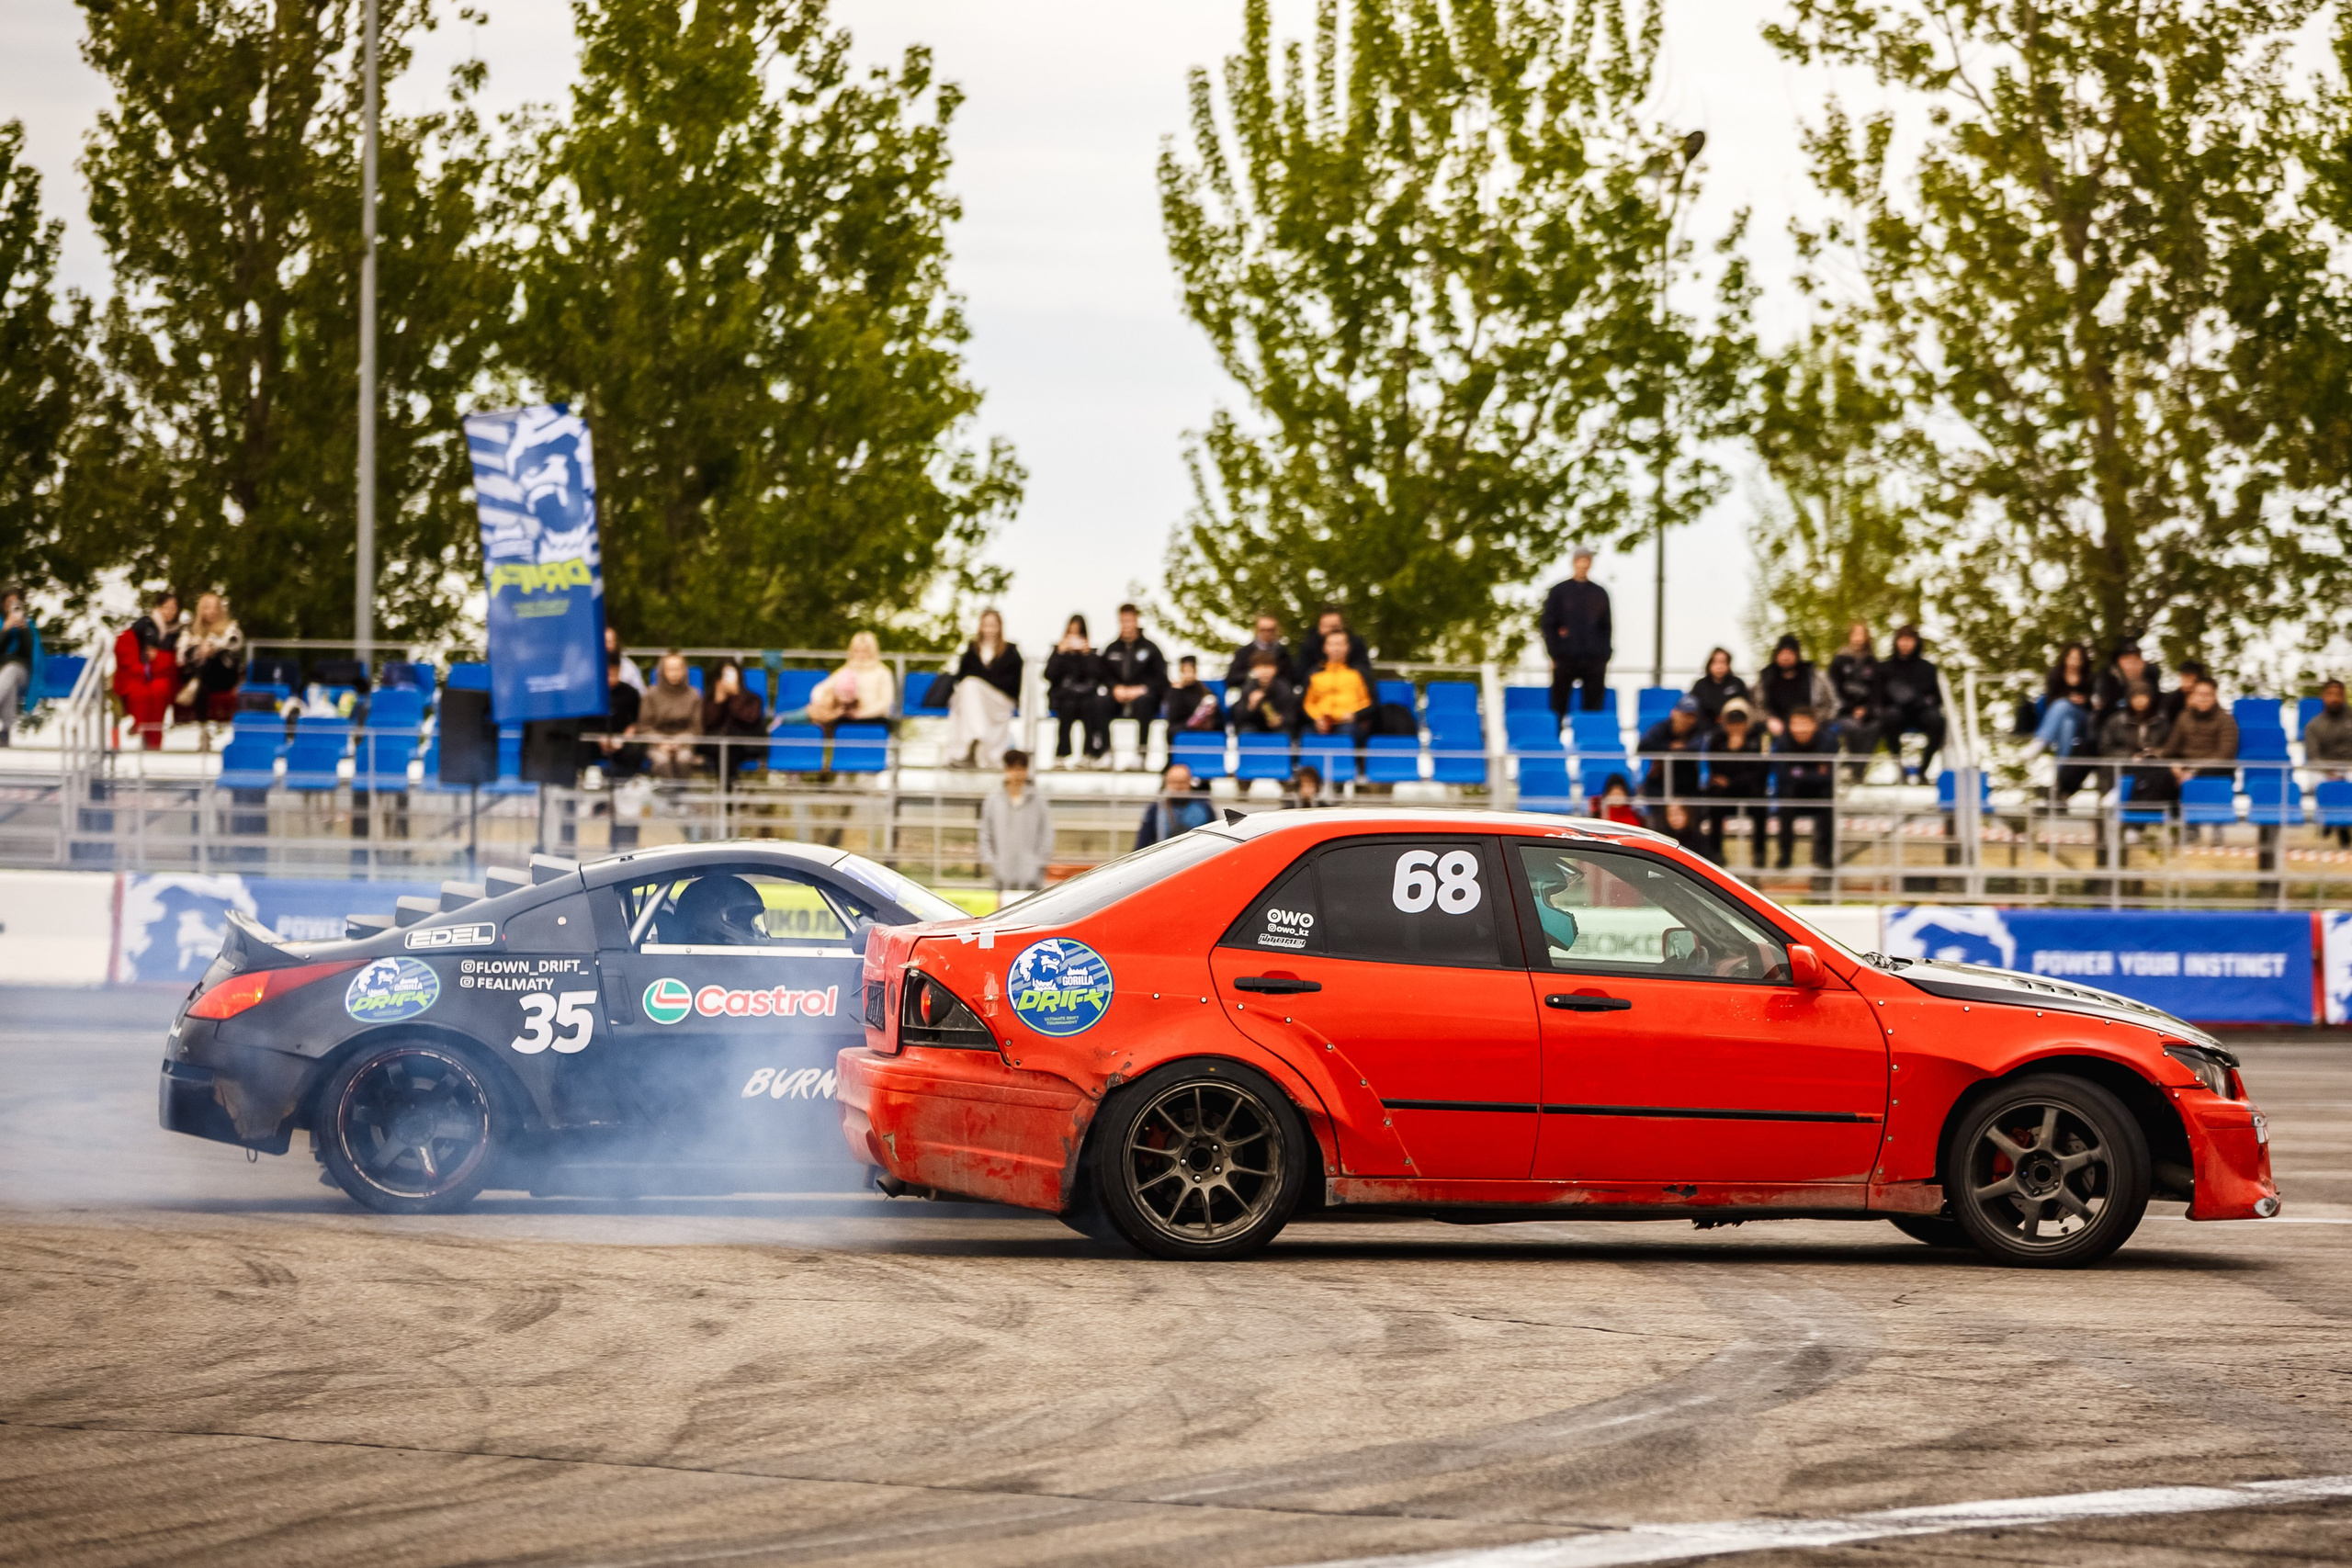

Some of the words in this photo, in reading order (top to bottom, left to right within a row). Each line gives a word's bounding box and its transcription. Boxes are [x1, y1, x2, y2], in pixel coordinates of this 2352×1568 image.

[1392, 849, 1482, 915] 68
[1267, 908, 1315, 928] OWO
[410, 926, 493, 947] EDEL
[476, 959, 589, 975] FLOWN_DRIFT_
[2031, 950, 2113, 976] POWER
[2118, 951, 2179, 976] YOUR
[2183, 953, 2288, 977] INSTINCT
[393, 982, 424, 992] GORILLA
[477, 977, 555, 991] FEALMATY
[1062, 975, 1094, 986] GORILLA
[350, 991, 431, 1012] DRIFT
[695, 986, 837, 1016] Castrol
[1016, 988, 1104, 1013] DRIFT
[510, 990, 597, 1055] 35
